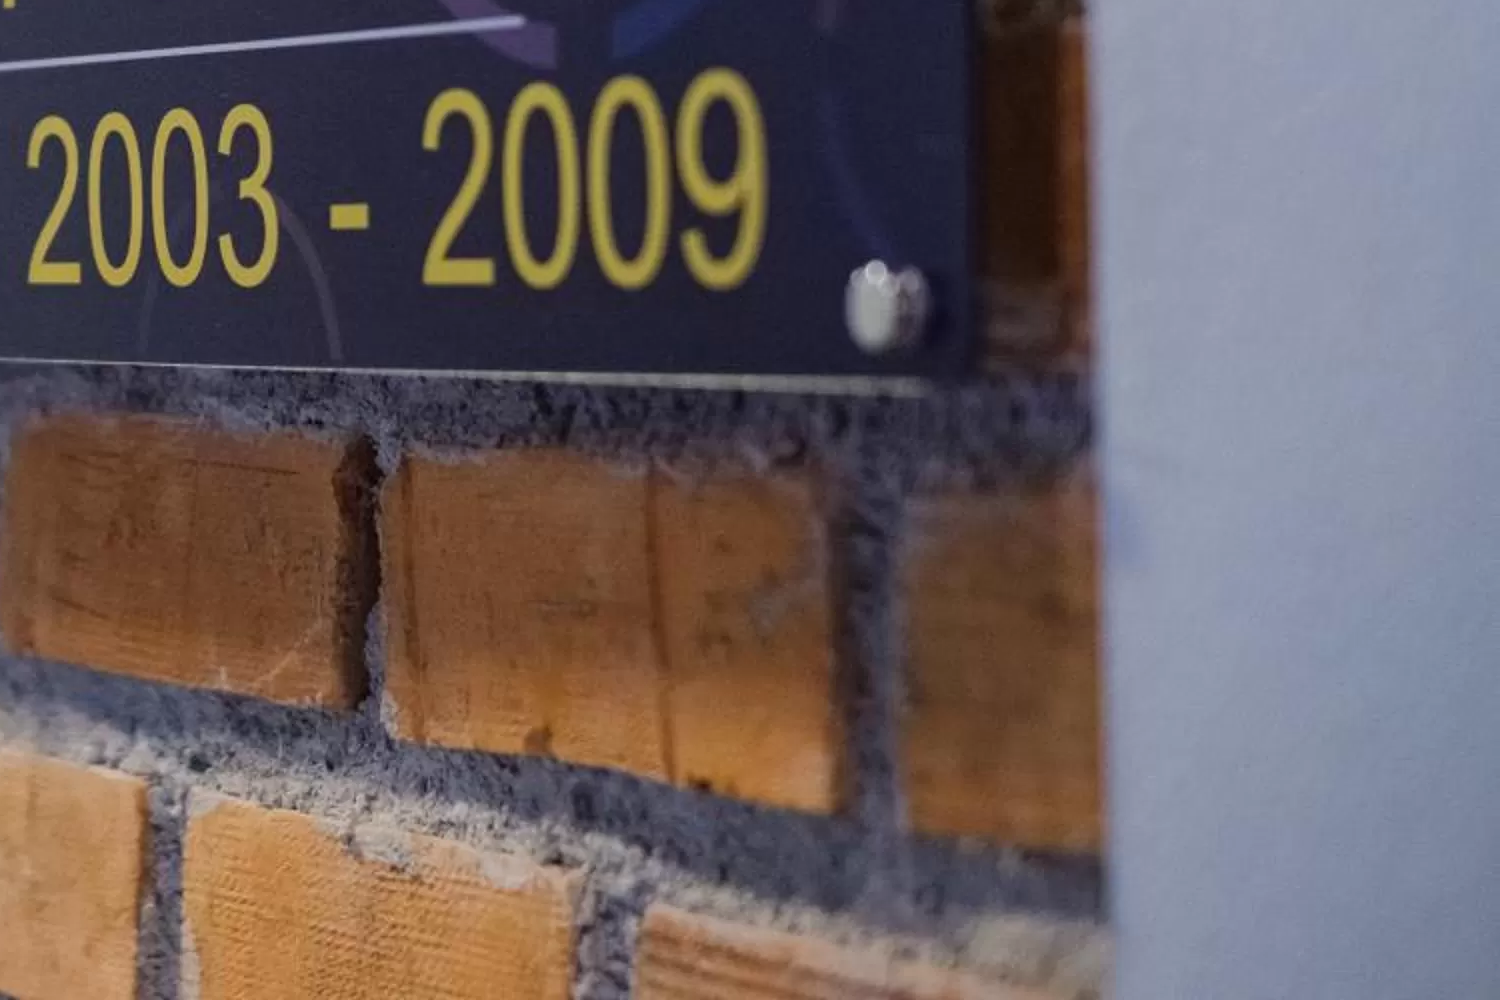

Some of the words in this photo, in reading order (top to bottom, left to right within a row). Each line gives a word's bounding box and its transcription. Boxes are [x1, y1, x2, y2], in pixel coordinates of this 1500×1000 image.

[26, 102, 280, 289] 2003
[328, 201, 371, 231] -
[421, 68, 767, 290] 2009
